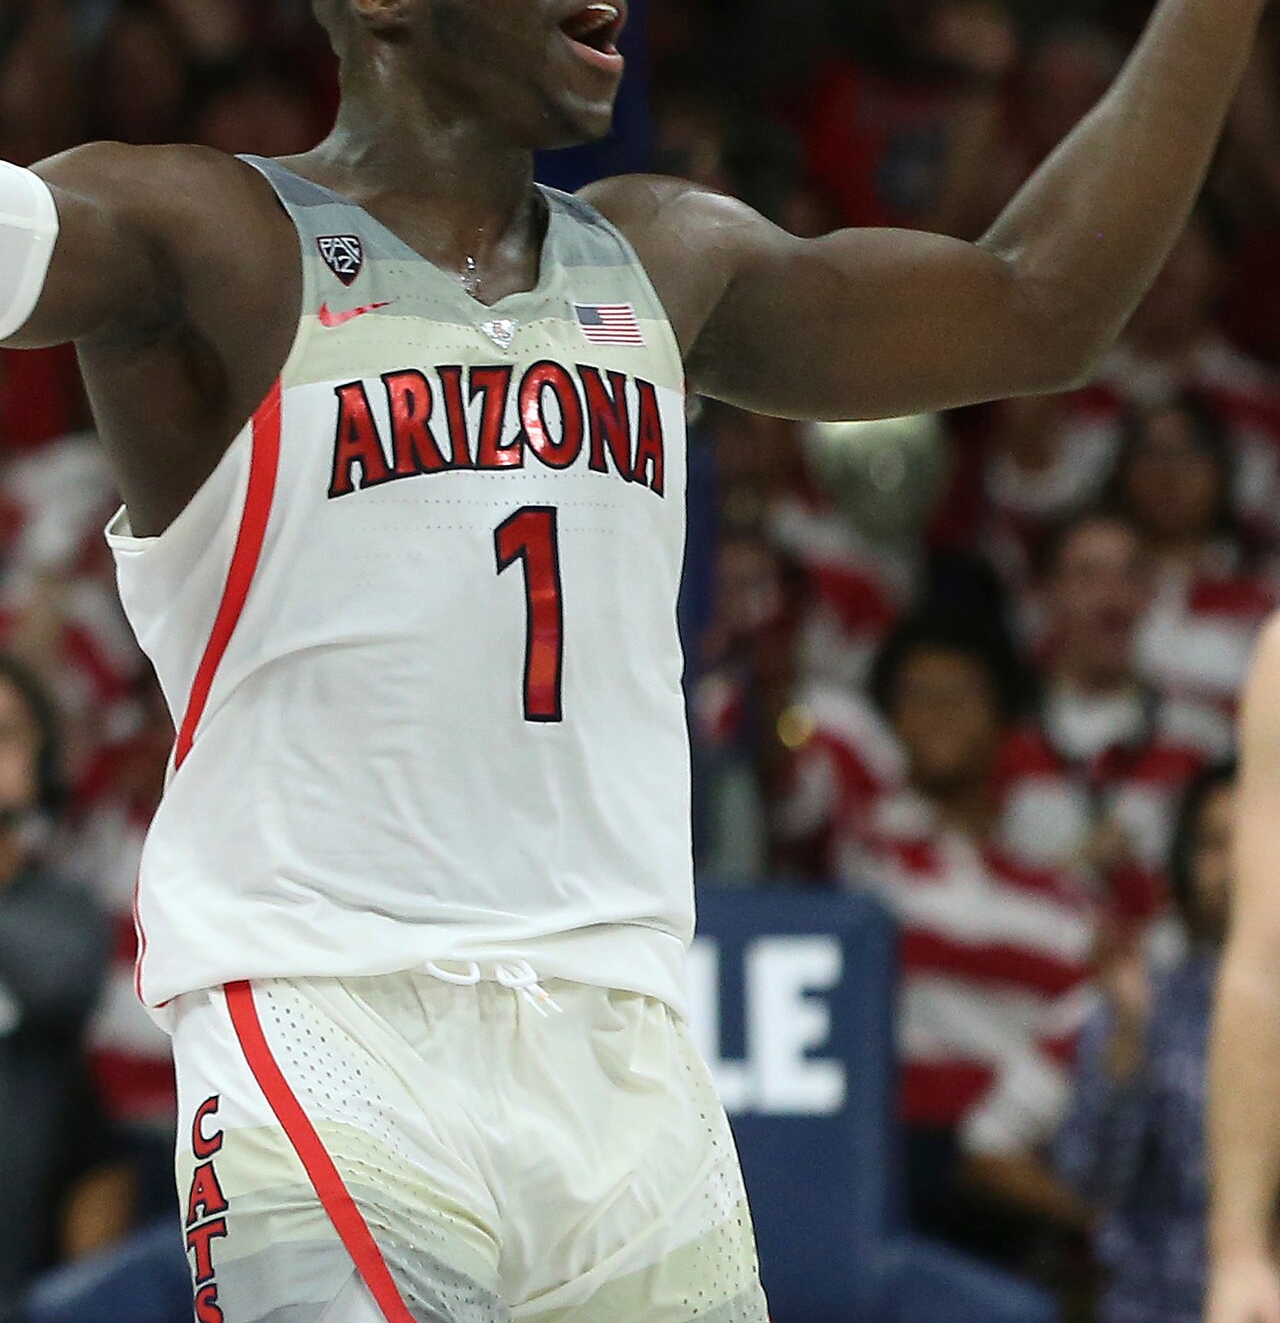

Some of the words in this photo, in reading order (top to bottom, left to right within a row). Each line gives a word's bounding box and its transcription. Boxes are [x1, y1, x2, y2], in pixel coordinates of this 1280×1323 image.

[327, 360, 665, 499] ARIZONA
[493, 505, 563, 723] 1
[186, 1094, 229, 1323] CATS
